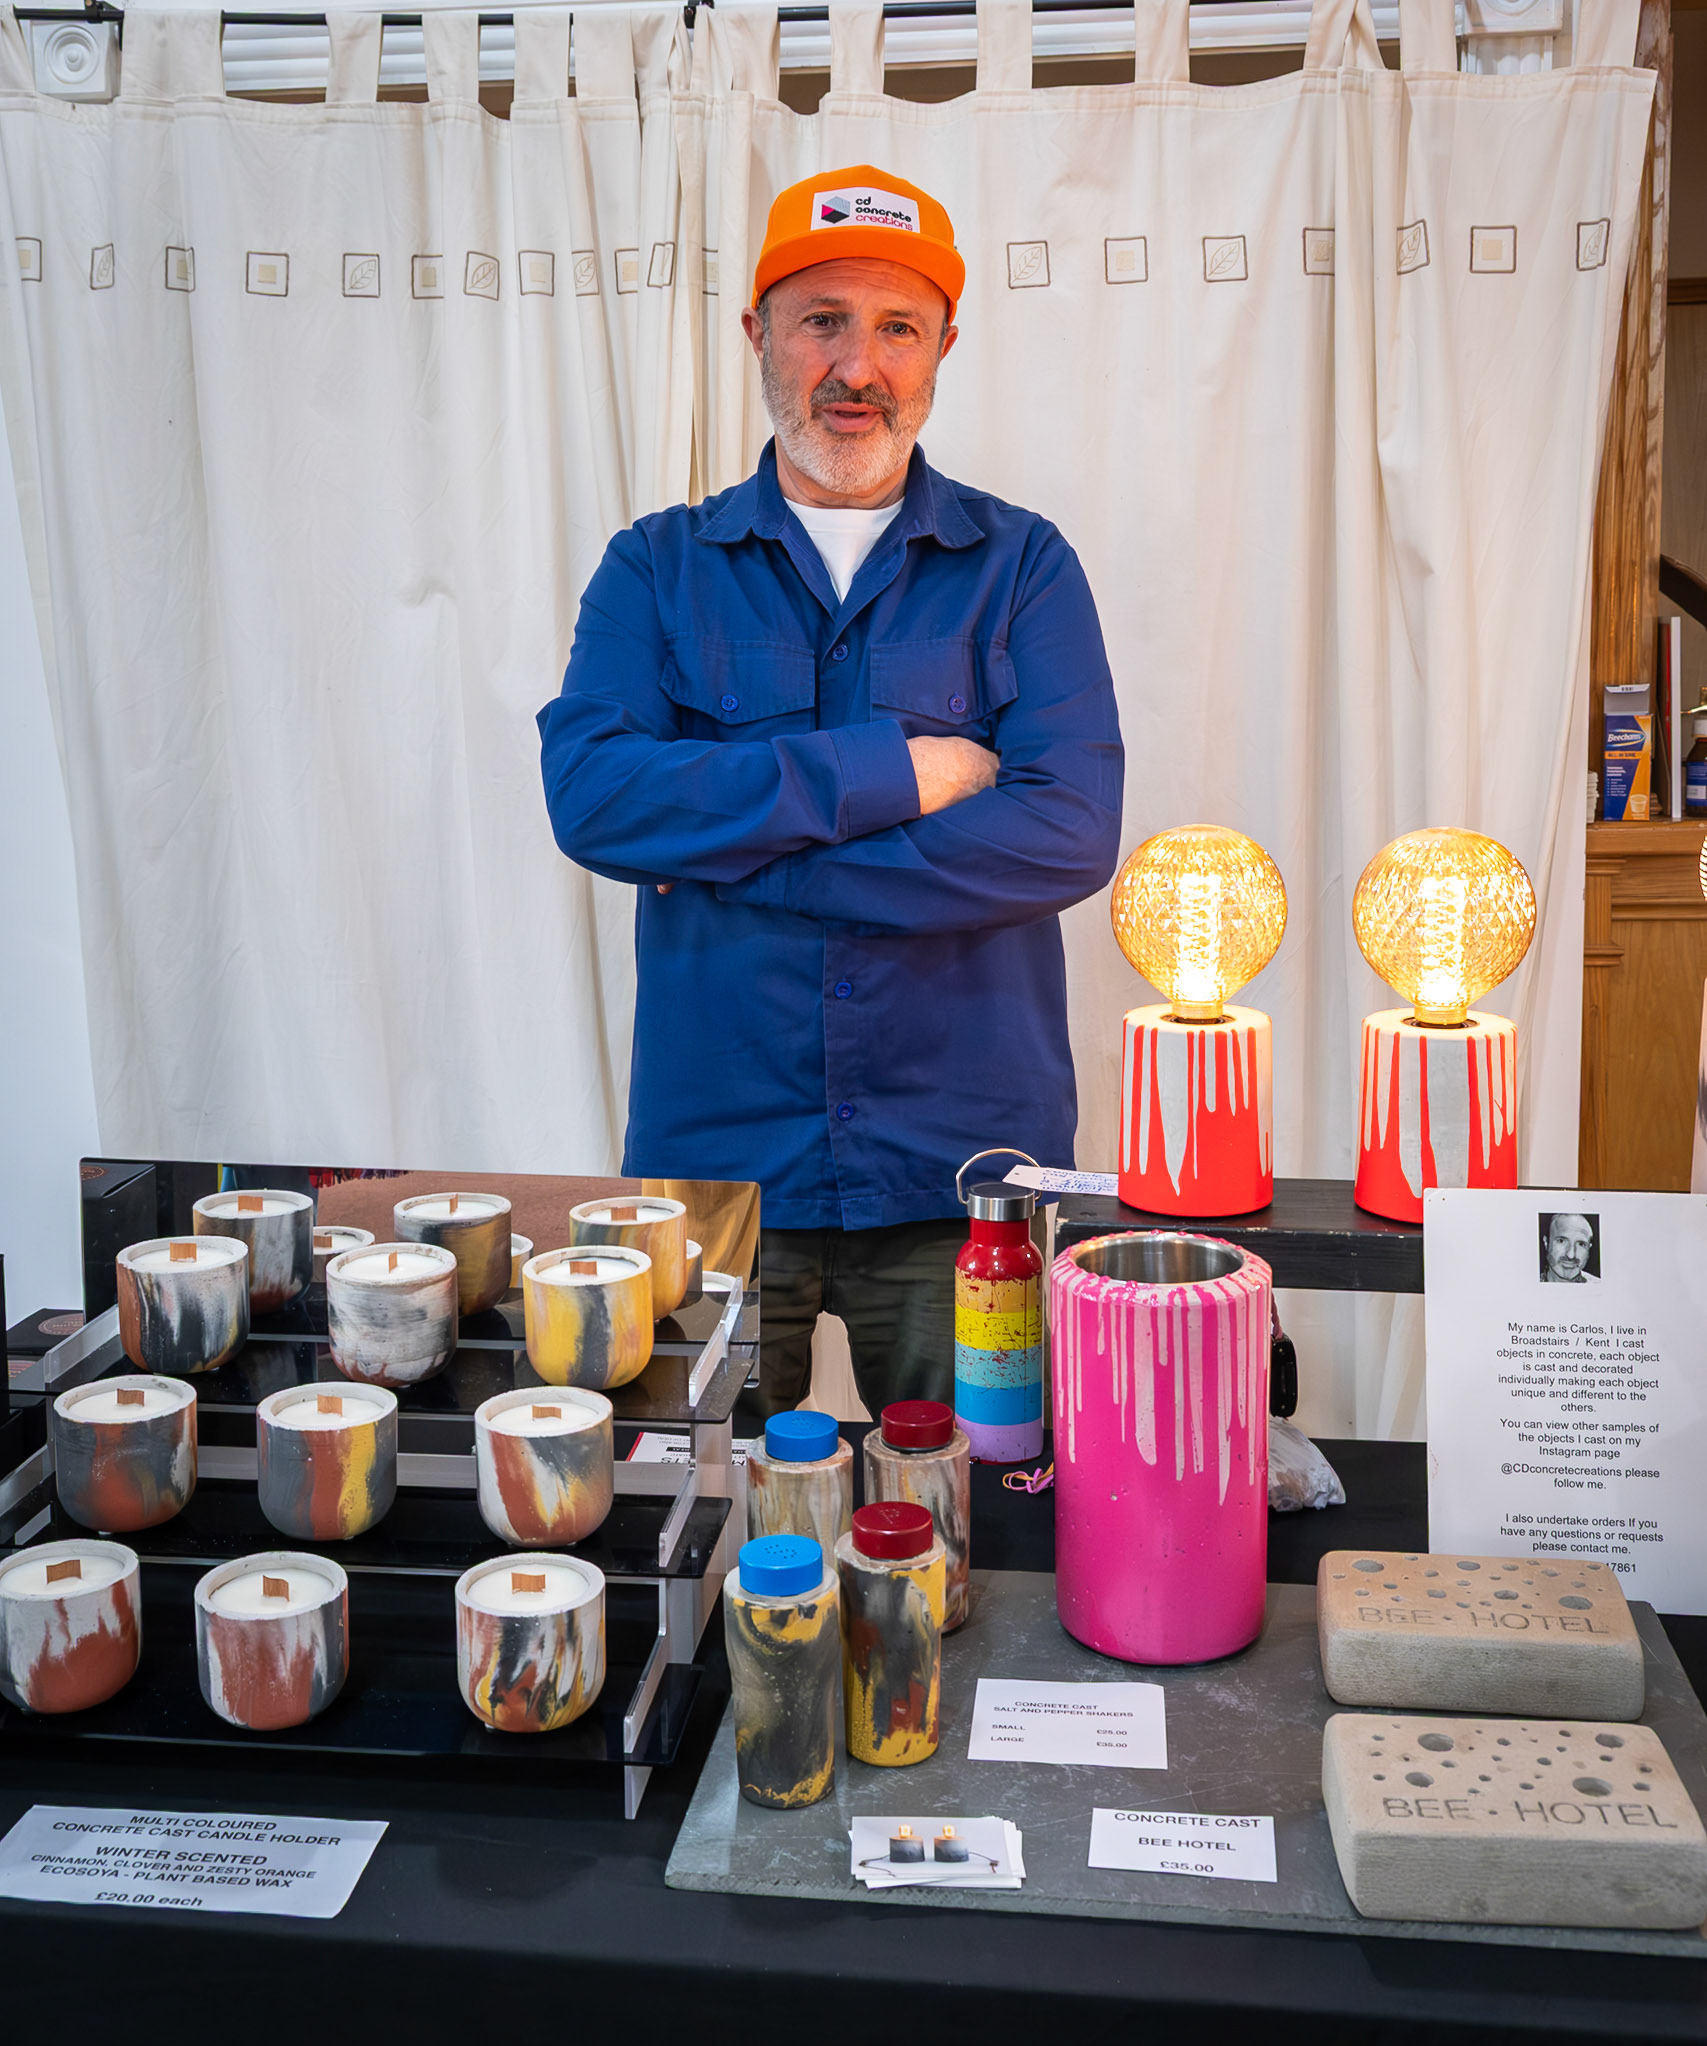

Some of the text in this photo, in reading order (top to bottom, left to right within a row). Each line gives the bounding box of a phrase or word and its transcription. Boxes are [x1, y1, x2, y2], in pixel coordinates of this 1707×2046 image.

[855, 196, 871, 206] cd
[855, 206, 912, 223] concrete
[855, 214, 913, 231] creations
[1508, 1322, 1524, 1334] My
[1527, 1325, 1556, 1333] name
[1559, 1324, 1567, 1333] is
[1570, 1324, 1607, 1335] Carlos,
[1617, 1325, 1634, 1335] live
[1637, 1326, 1647, 1335] in
[1511, 1335, 1570, 1346] Broadstairs
[1585, 1337, 1610, 1347] Kent
[1622, 1339, 1644, 1348] cast
[1496, 1348, 1660, 1364] objects in concrete, each object
[1523, 1362, 1633, 1374] is cast and decorated
[1498, 1374, 1659, 1390] individually making each object
[1511, 1388, 1646, 1401] unique and different to the
[1561, 1402, 1596, 1412] others.
[1500, 1418, 1659, 1434] You can view other samples of
[1518, 1432, 1535, 1442] the
[1537, 1433, 1575, 1445] objects
[1584, 1436, 1606, 1445] cast
[1609, 1437, 1622, 1445] on
[1625, 1438, 1641, 1448] my
[1539, 1446, 1620, 1460] Instagram page
[1501, 1463, 1660, 1479] @CDconcretecreations please
[1554, 1478, 1606, 1489] follow me.
[1512, 1514, 1534, 1523] also
[1537, 1515, 1589, 1526] undertake
[1591, 1517, 1626, 1527] orders
[1629, 1518, 1635, 1527] If
[1638, 1520, 1658, 1530] you
[1500, 1526, 1664, 1543] have any questions or requests
[1533, 1541, 1631, 1554] please contact me.
[1606, 1562, 1636, 1573] 7861
[1358, 1606, 1610, 1635] BEE HOTEL
[1114, 1813, 1260, 1828] CONCRETE CAST
[1383, 1797, 1678, 1829] BEE HOTEL
[130, 1816, 277, 1830] MULTI COLOURED
[52, 1822, 341, 1845] CONCRETE CAST CANDLE HOLDER
[1138, 1837, 1236, 1851] BEE HOTEL
[96, 1846, 267, 1865] WINTER SCENTED
[31, 1853, 316, 1878] CINNAMON, CLOVER AND ZESTY ORANGE
[1160, 1861, 1214, 1872] £35.00
[40, 1864, 119, 1877] ECOSOYA
[133, 1871, 190, 1882] PLANT
[192, 1875, 251, 1885] BASED
[255, 1878, 292, 1887] WAX
[95, 1892, 202, 1906] £20.00 each
